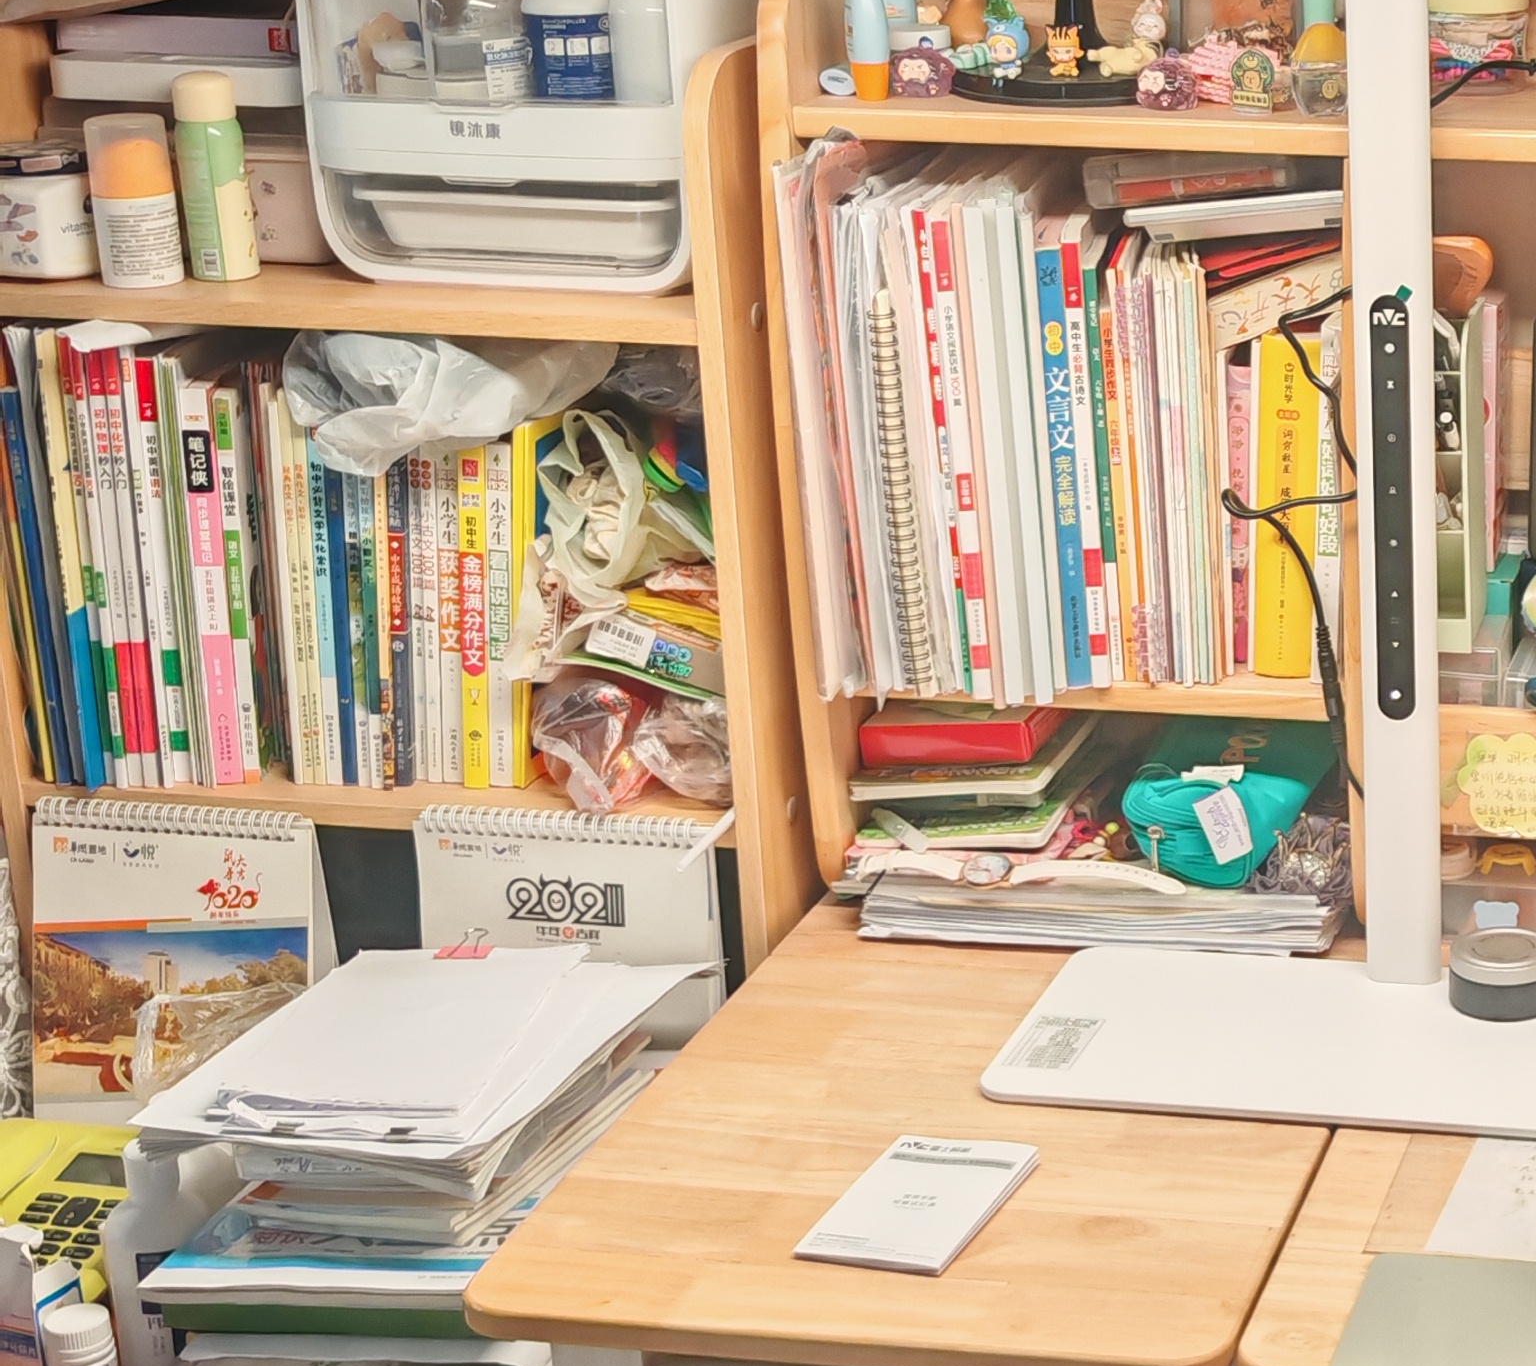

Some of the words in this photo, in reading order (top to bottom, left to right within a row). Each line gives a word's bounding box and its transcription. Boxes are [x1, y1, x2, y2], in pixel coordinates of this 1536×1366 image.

[1046, 324, 1062, 353] 初中
[1070, 321, 1087, 406] 高中生必背古诗文
[1045, 366, 1075, 452] 文言文
[110, 408, 128, 490] 初中化学秒入门
[188, 437, 209, 487] 笔记侠
[221, 466, 237, 517] 智绘课堂
[1055, 455, 1077, 526] 完全解读
[310, 461, 329, 578] 初中必背文学文化常识
[440, 496, 457, 546] 小学生
[465, 516, 477, 549] 初中生
[490, 497, 507, 546] 小学生
[462, 554, 484, 667] 金榜满分作文
[506, 874, 626, 927] 2021
